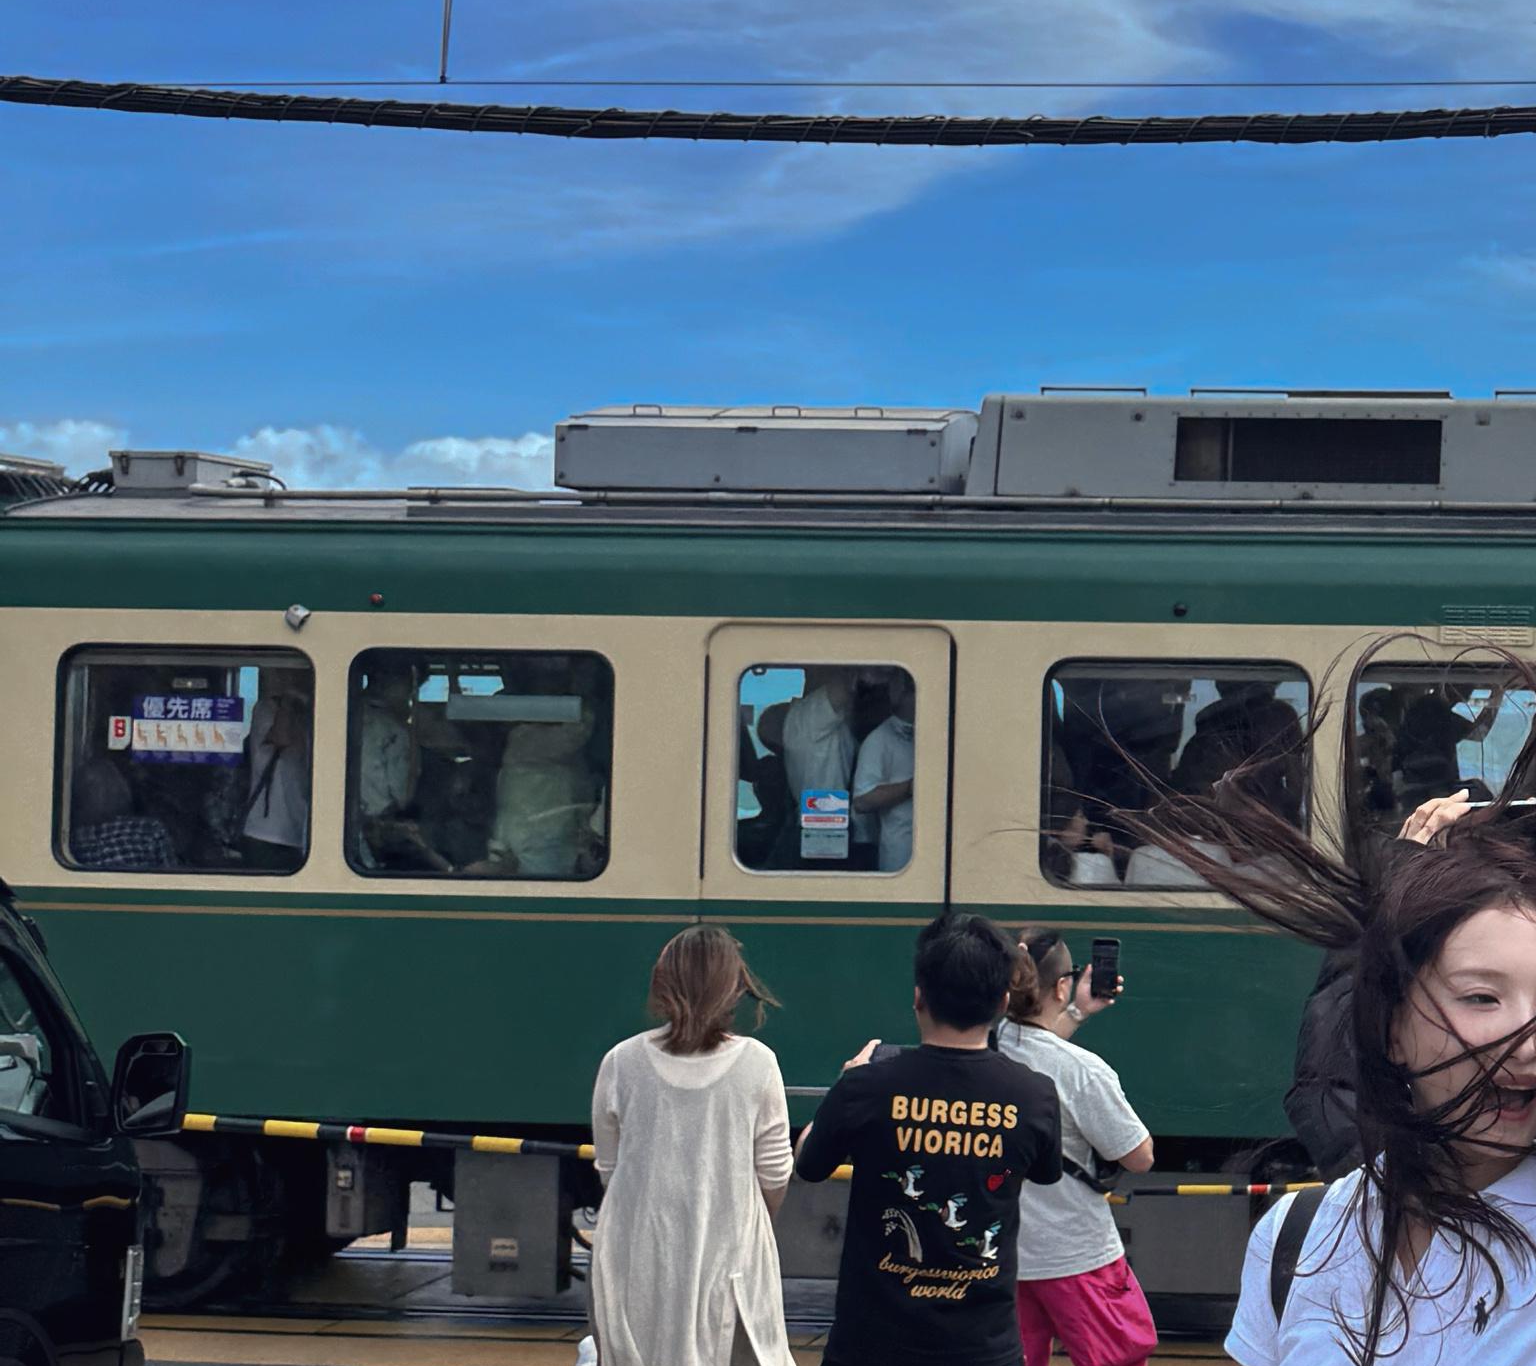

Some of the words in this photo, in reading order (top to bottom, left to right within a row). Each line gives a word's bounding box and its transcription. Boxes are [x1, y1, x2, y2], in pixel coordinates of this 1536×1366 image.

[142, 696, 214, 719] 優先席
[891, 1095, 1019, 1130] BURGESS
[896, 1126, 1004, 1158] VIORICA
[911, 1281, 971, 1300] world
